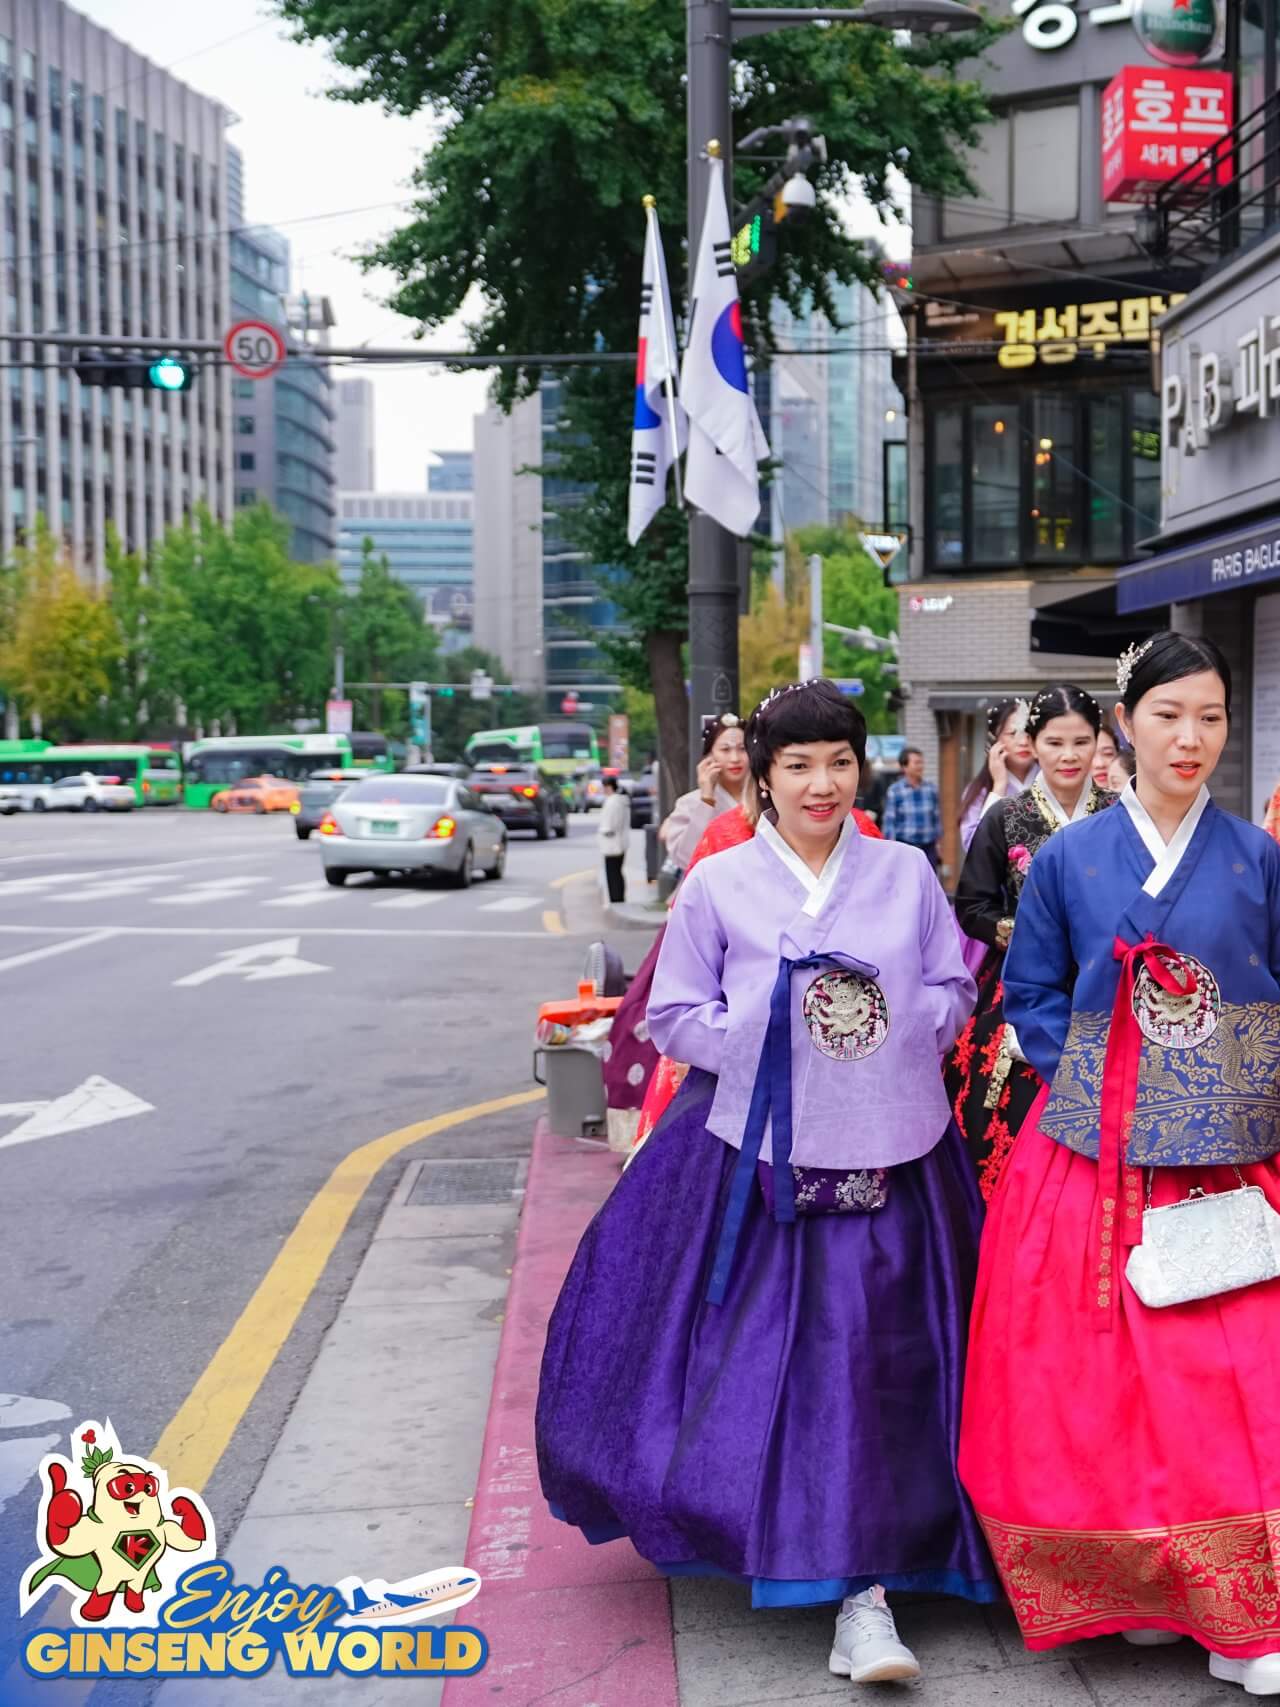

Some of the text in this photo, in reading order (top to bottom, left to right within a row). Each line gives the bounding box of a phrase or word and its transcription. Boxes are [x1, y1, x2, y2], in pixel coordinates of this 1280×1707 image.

[1129, 79, 1229, 133] 호프
[1140, 143, 1177, 166] 세계
[237, 336, 273, 364] 50
[1212, 551, 1242, 582] PARIS
